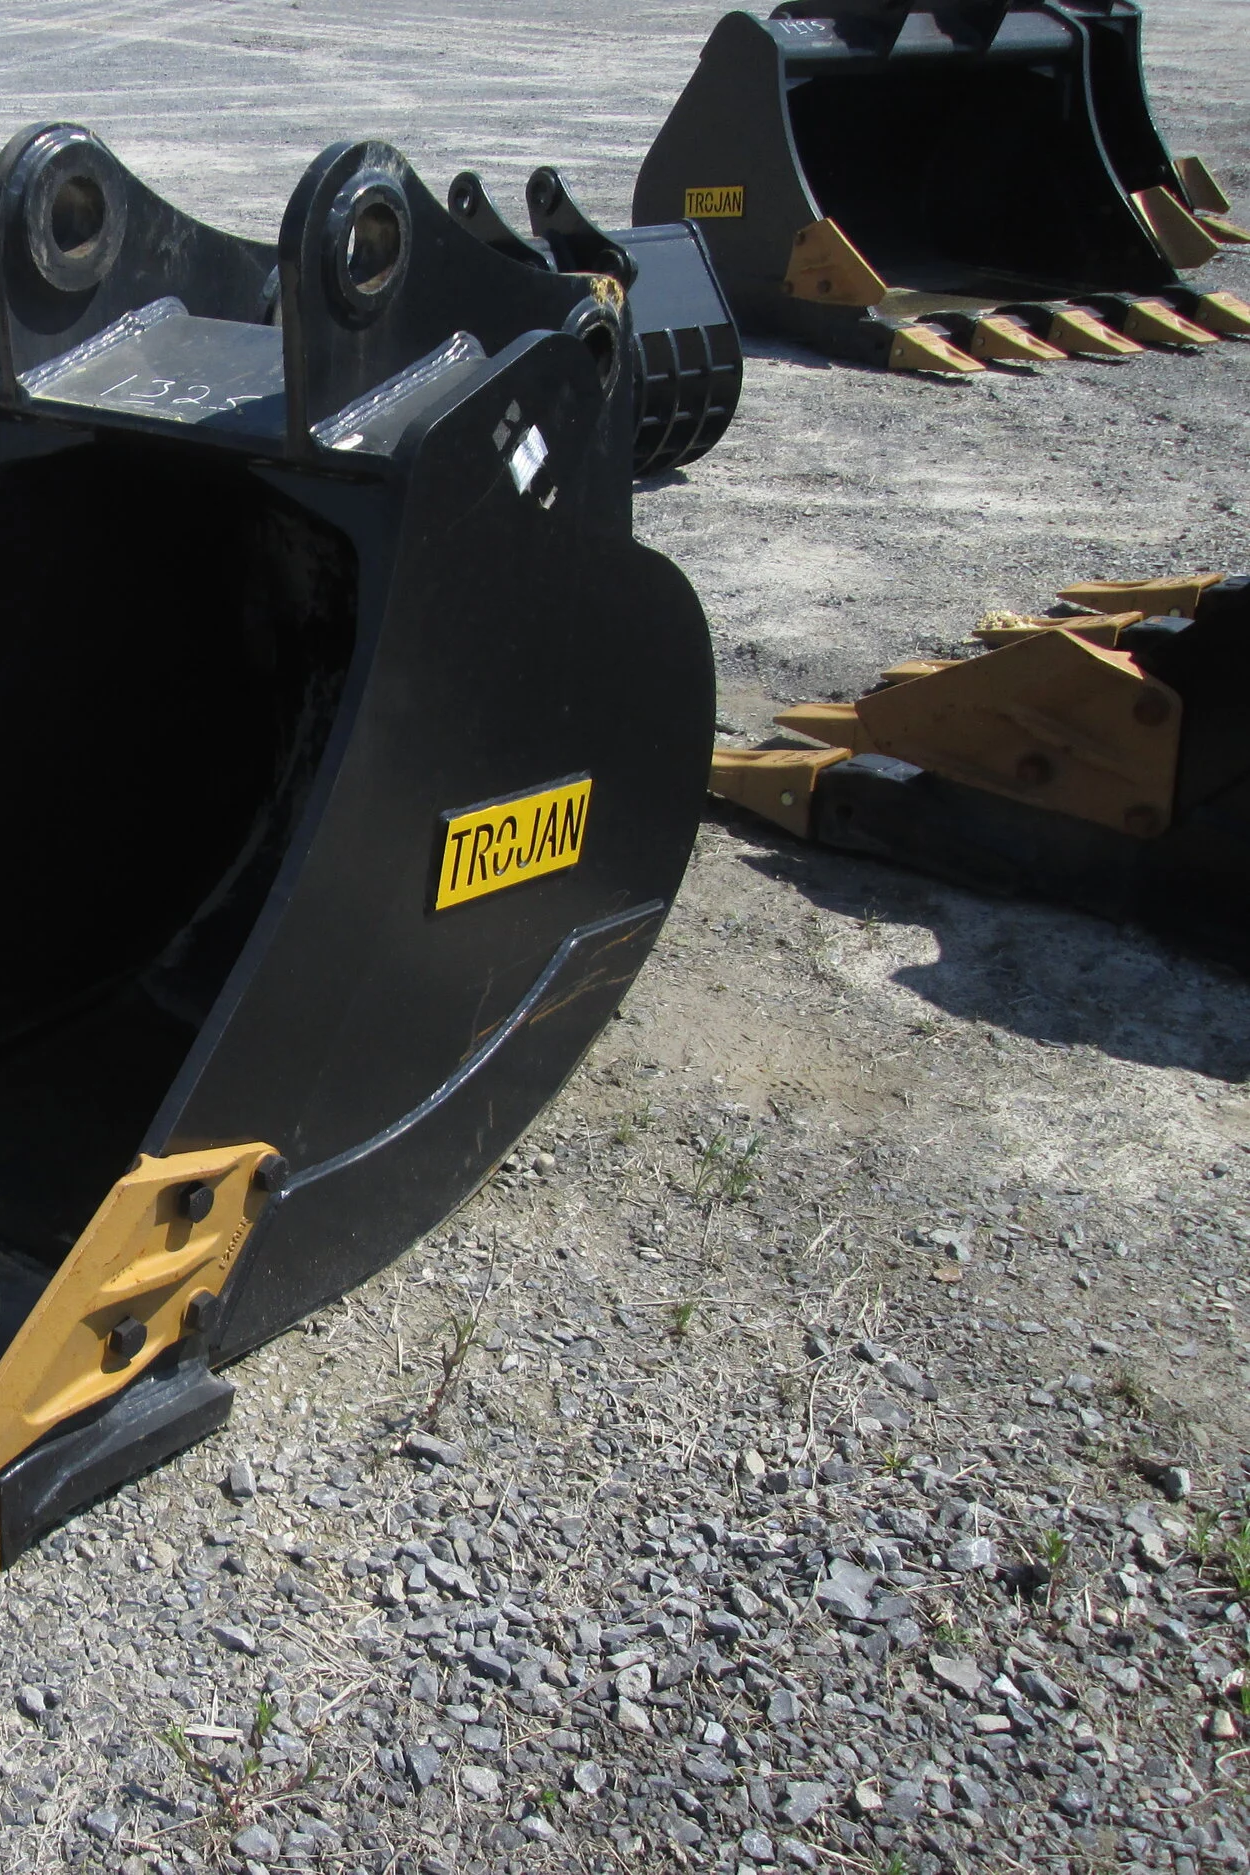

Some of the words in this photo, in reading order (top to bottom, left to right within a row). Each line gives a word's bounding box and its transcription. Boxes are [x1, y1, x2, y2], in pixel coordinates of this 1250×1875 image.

[686, 191, 742, 214] TROJAN
[99, 374, 264, 411] 1325
[449, 794, 586, 892] TROJAN
